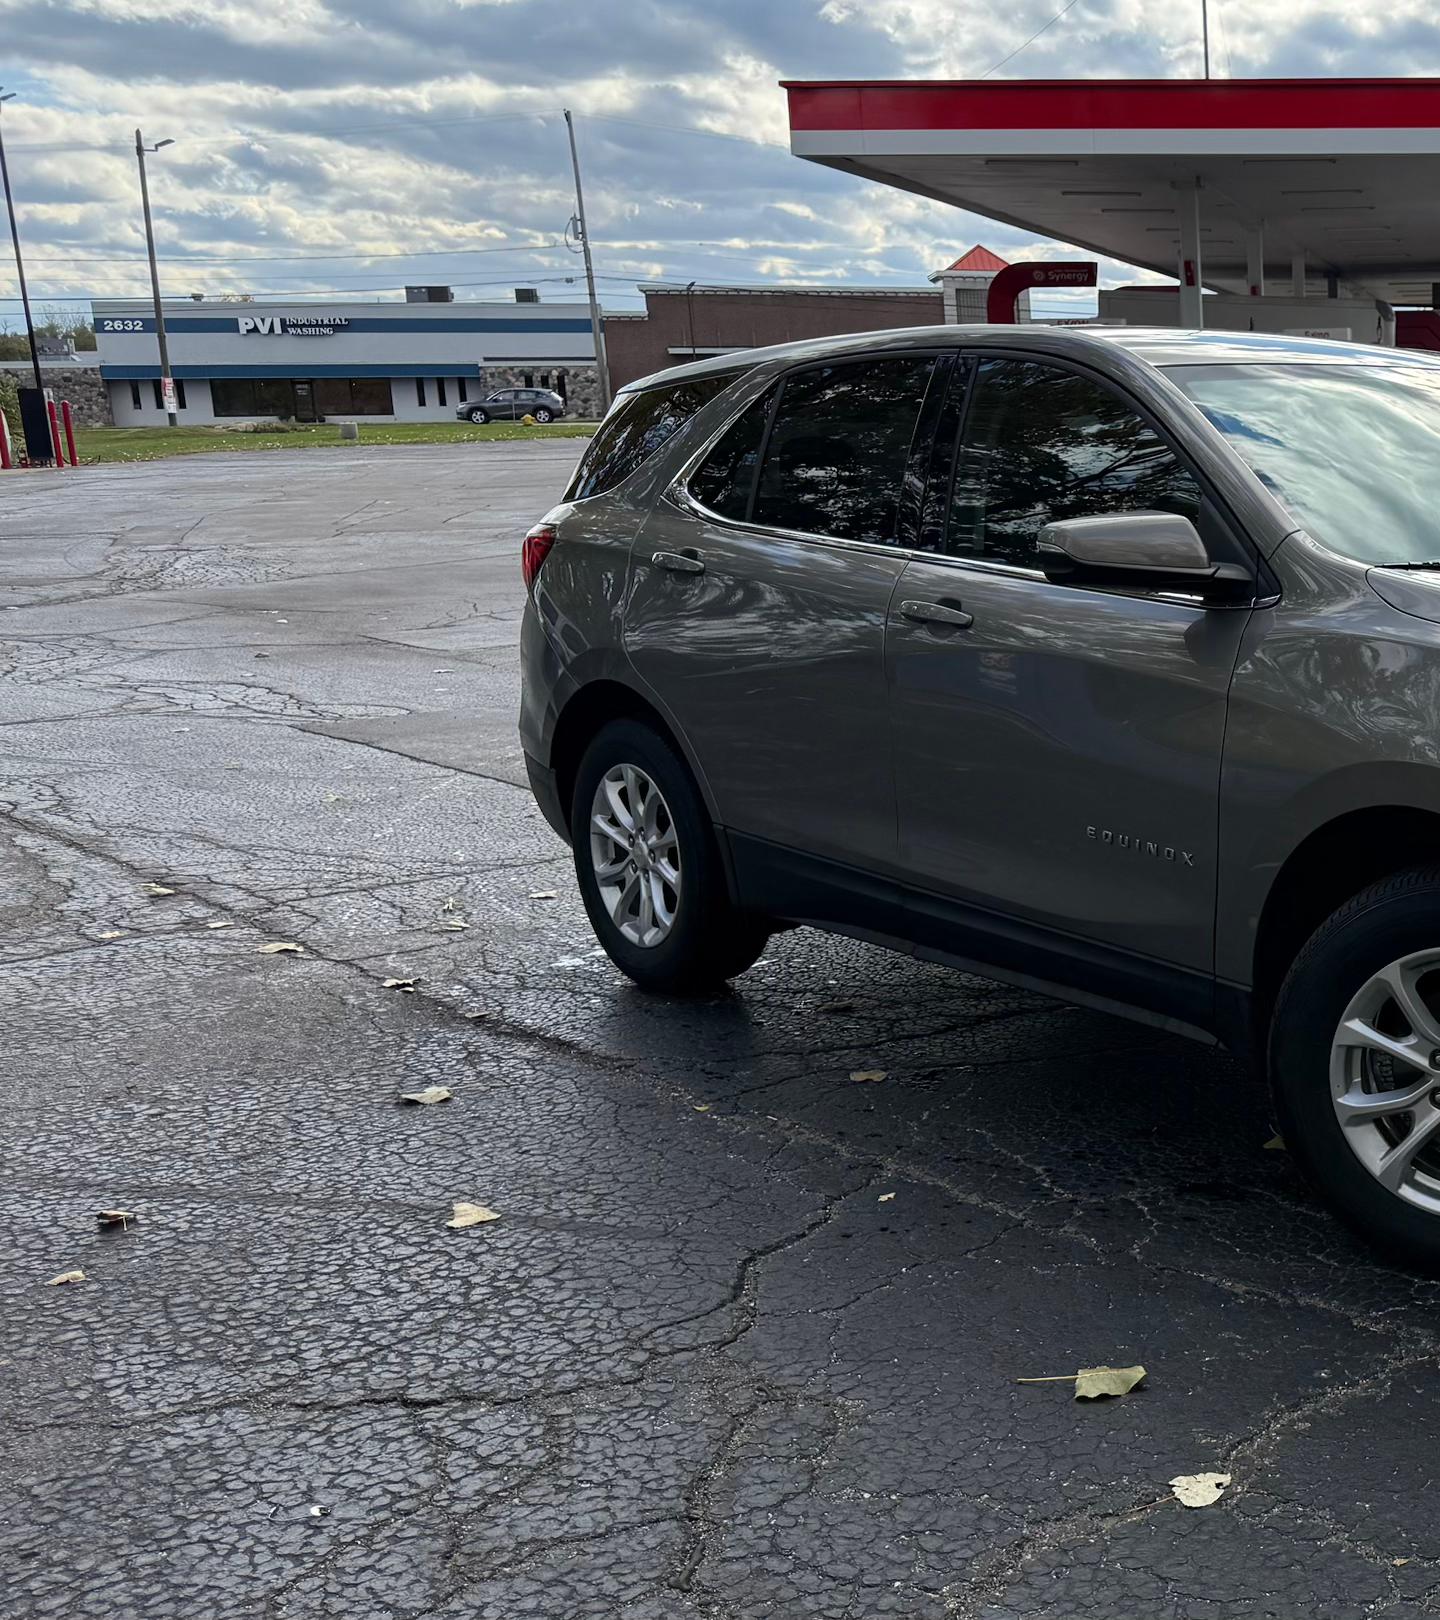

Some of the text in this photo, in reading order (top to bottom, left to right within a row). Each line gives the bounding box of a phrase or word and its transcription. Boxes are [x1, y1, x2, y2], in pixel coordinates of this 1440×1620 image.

[1047, 271, 1089, 282] Synergy
[103, 320, 144, 331] 2632
[238, 317, 282, 335] PVI
[286, 317, 349, 325] INDUSTRIAL
[287, 327, 334, 335] WASHING
[1086, 825, 1193, 867] EQUINOX
